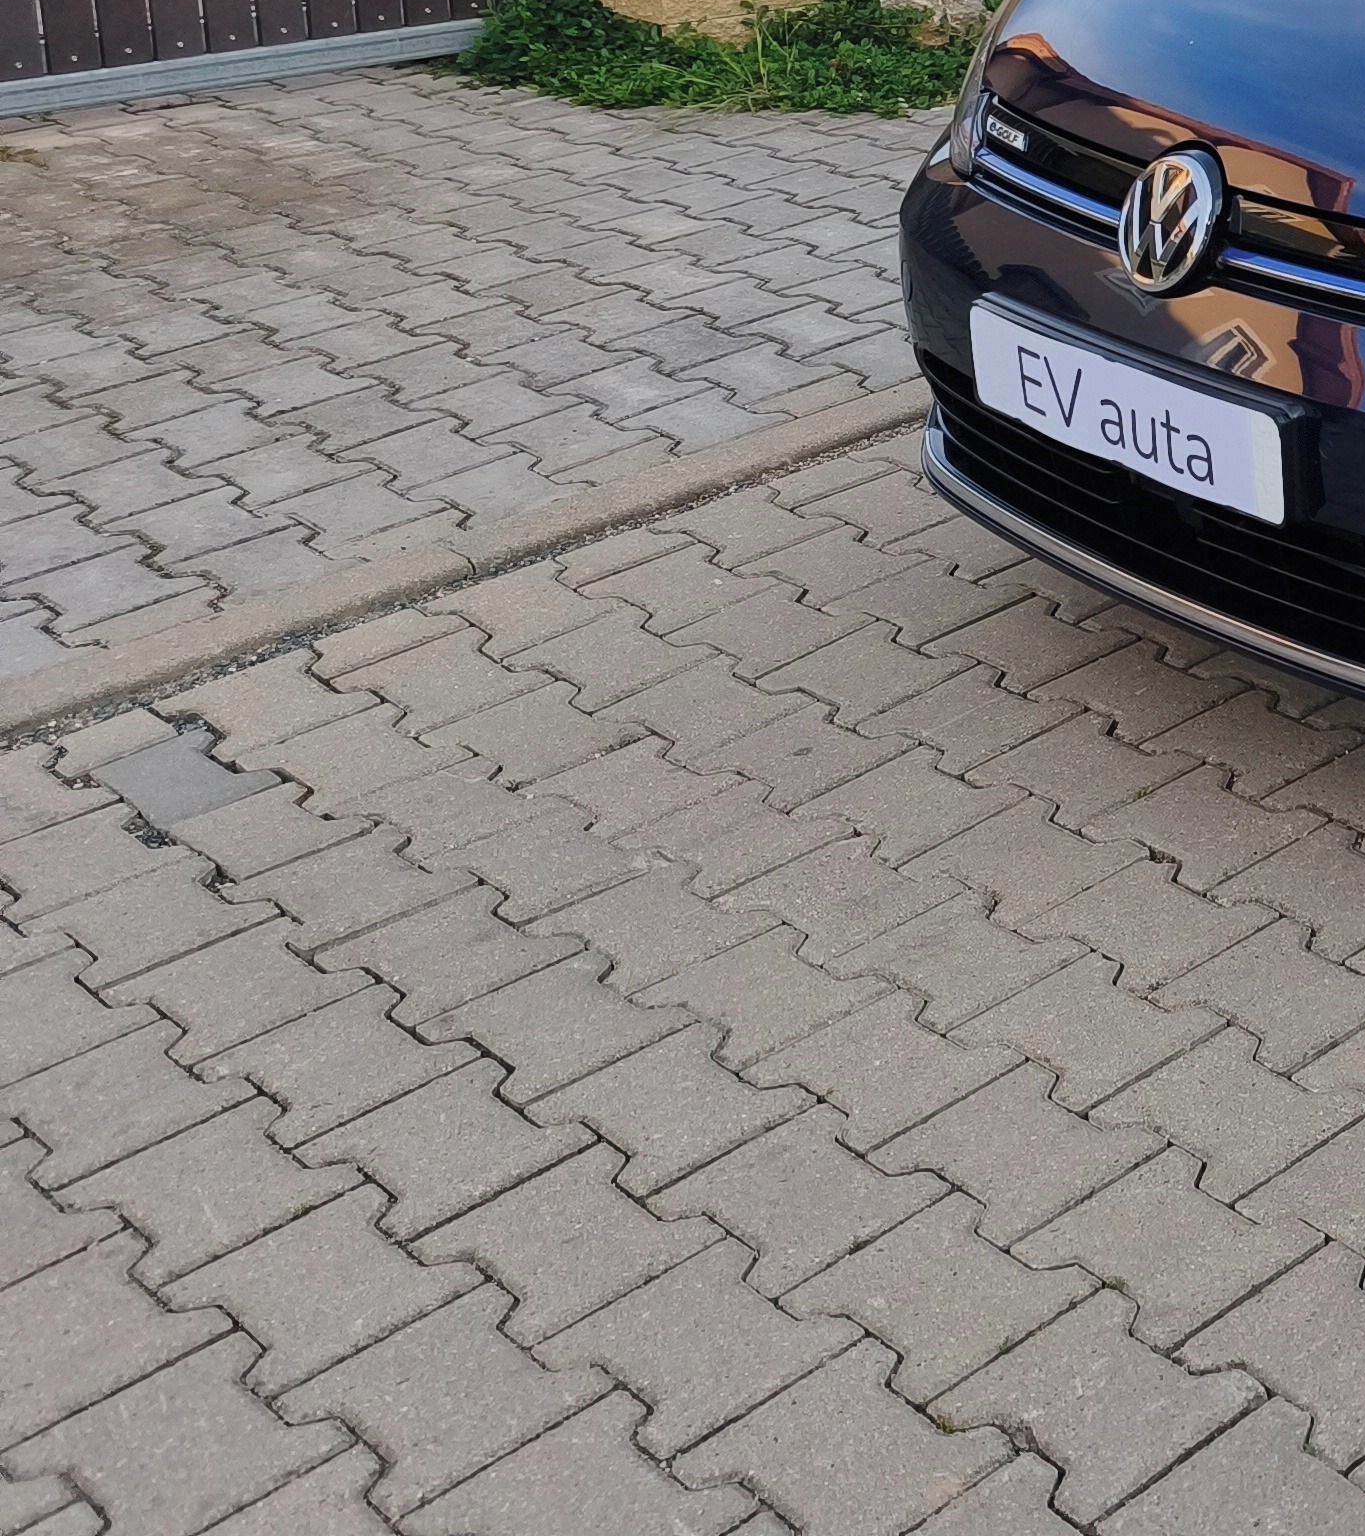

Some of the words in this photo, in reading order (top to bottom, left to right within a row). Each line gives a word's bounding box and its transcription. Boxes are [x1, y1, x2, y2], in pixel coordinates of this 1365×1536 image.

[1122, 155, 1211, 290] VW
[1017, 345, 1083, 428] EV
[1099, 397, 1215, 486] auta
